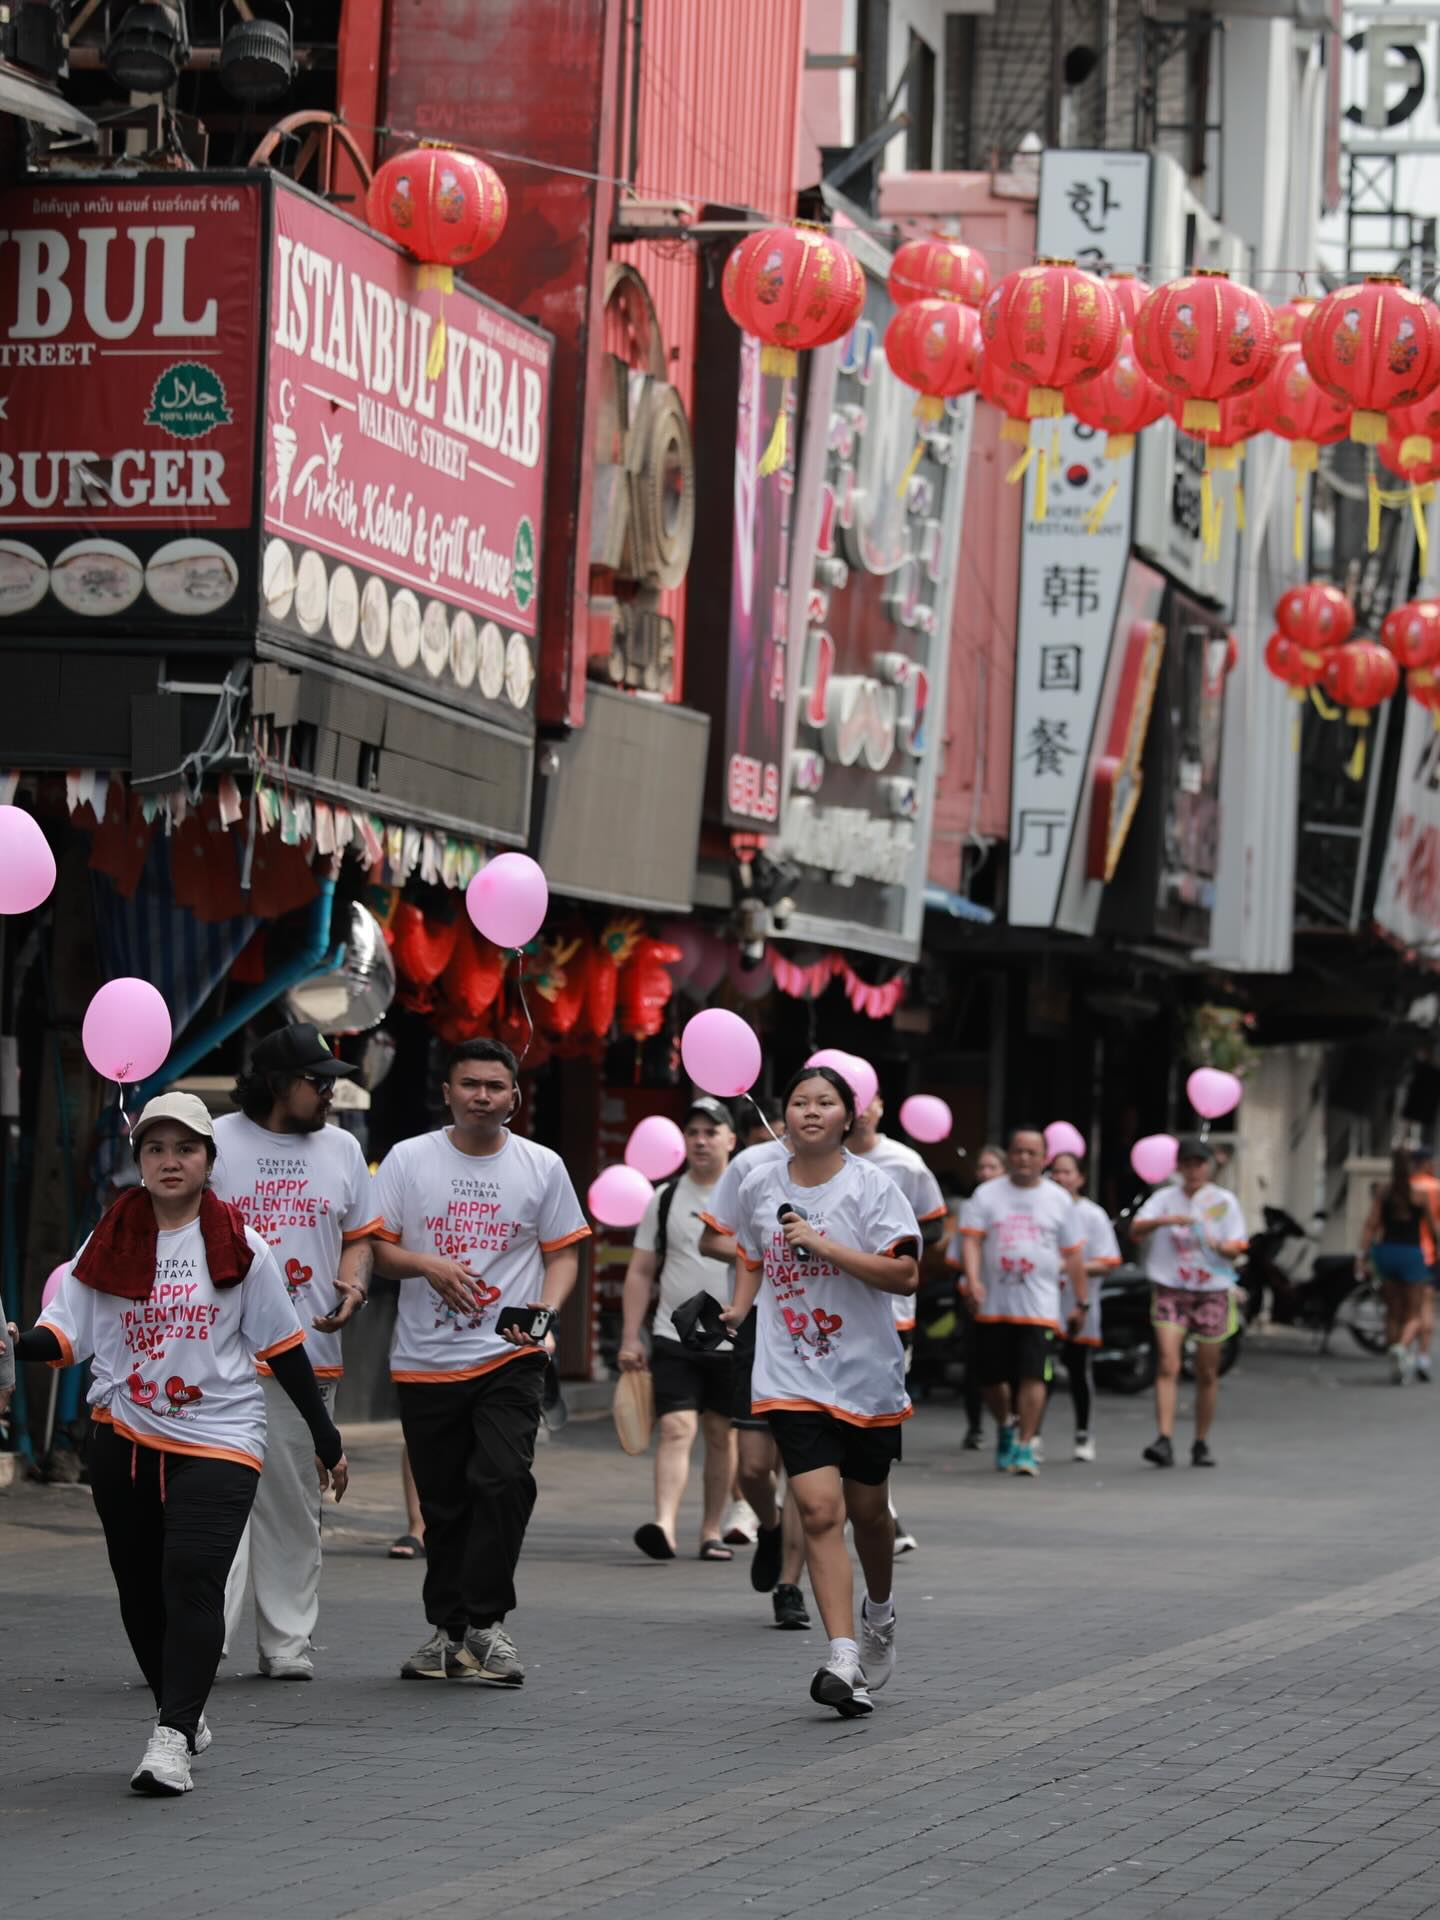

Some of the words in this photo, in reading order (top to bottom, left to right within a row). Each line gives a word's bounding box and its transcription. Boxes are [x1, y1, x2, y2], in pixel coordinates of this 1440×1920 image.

[210, 194, 240, 212] จำกัด
[0, 226, 218, 341] BUL
[274, 234, 437, 420] ISTANBUL
[443, 325, 542, 468] KEBAB
[161, 376, 218, 409] حلال
[184, 411, 217, 421] HALAL
[356, 392, 418, 457] WALKING
[419, 424, 469, 482] STREET
[293, 422, 358, 538] Turkish
[360, 483, 413, 558] Kebab
[413, 505, 428, 566] &
[429, 514, 469, 583] Grill
[464, 524, 511, 598] House
[1015, 563, 1100, 858] 韩国餐厅
[256, 1158, 308, 1167] CENTRAL
[260, 1166, 305, 1175] PATTAYA
[255, 1179, 309, 1197] HAPPY
[451, 1179, 501, 1190] CENTRAL
[453, 1187, 498, 1198] PATTAYA
[231, 1195, 331, 1216] VALENTINE'S
[447, 1200, 502, 1221] HAPPY
[254, 1222, 277, 1233] OVE
[279, 1213, 318, 1228] 2026
[425, 1215, 522, 1238] VALENTINE'S
[434, 1232, 465, 1250] DAY
[469, 1236, 510, 1252] 2026
[439, 1243, 469, 1257] LOVE
[155, 1259, 198, 1269] NTRAL
[766, 1263, 796, 1279] DAY
[800, 1264, 840, 1277] 2026
[155, 1269, 193, 1279] TTAYA
[772, 1271, 800, 1288] LOVE
[133, 1283, 198, 1307] APPY
[165, 1324, 209, 1341] 2026
[131, 1334, 164, 1354] LOVE
